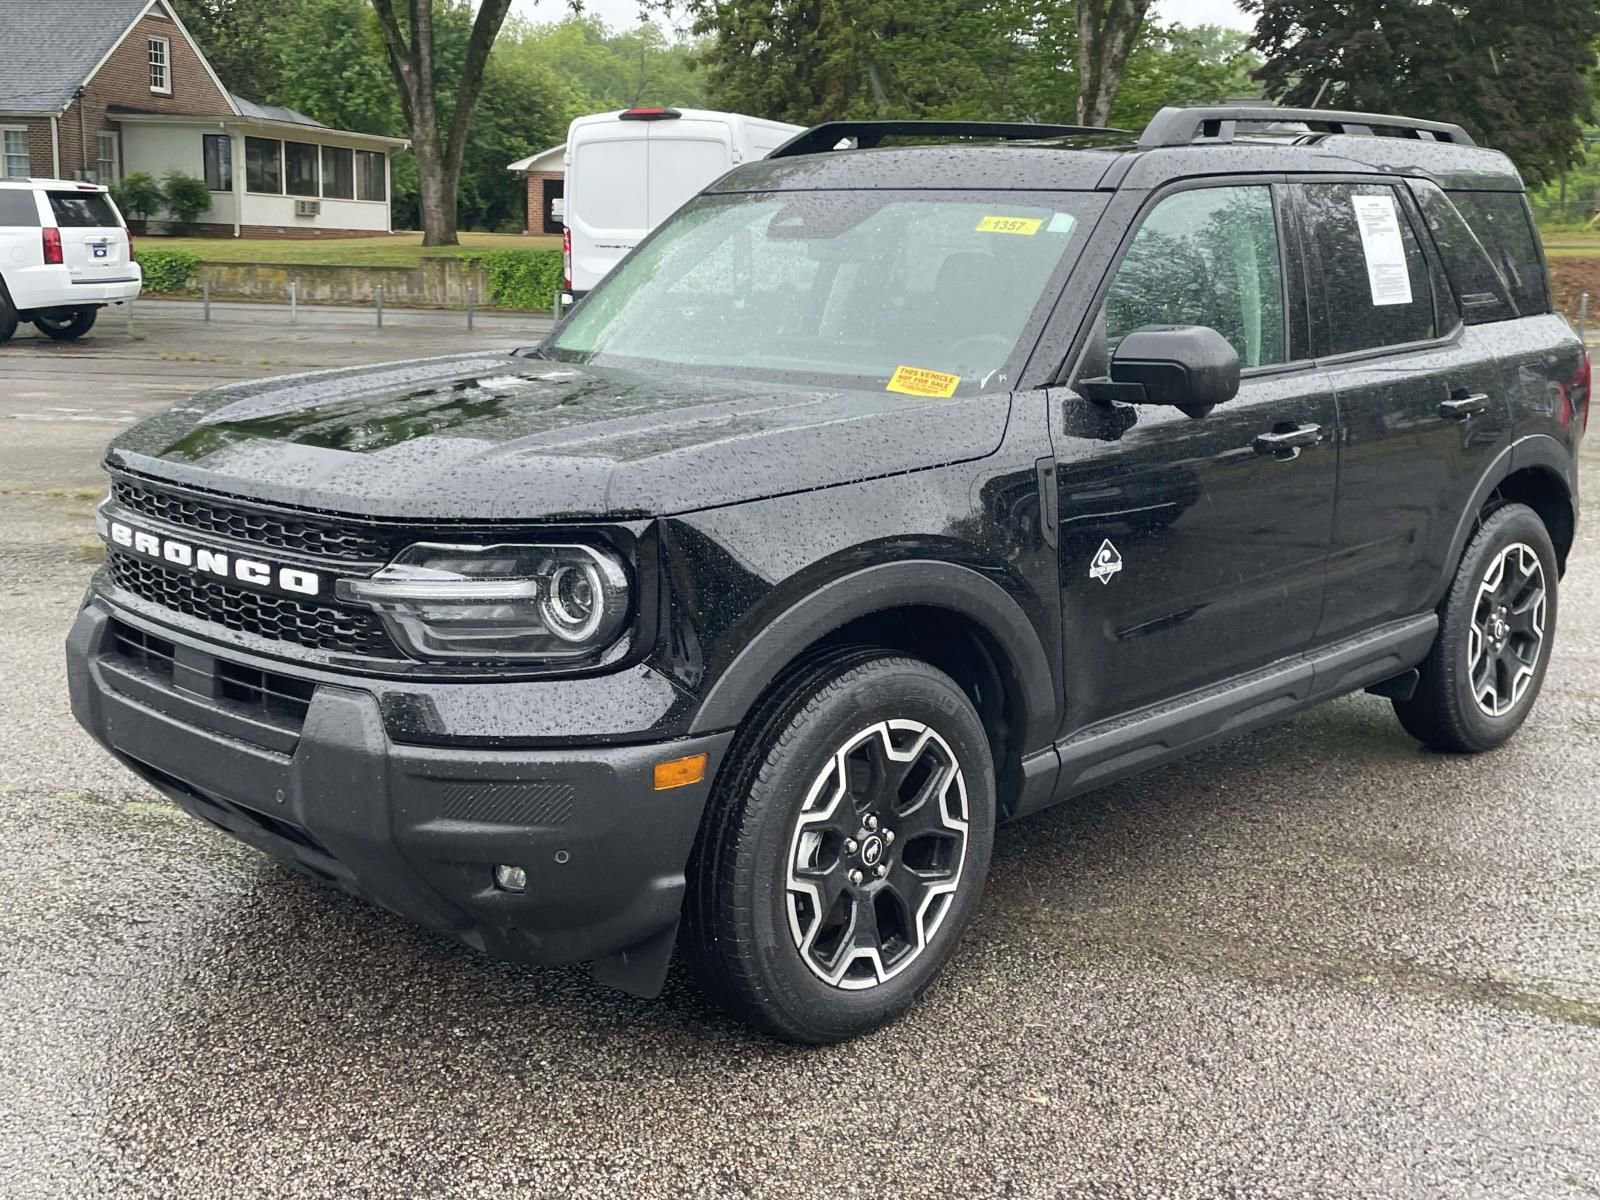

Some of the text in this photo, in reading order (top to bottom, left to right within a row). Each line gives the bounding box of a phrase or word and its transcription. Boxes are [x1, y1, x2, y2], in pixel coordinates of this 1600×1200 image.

[993, 220, 1027, 231] 1357
[898, 374, 913, 382] NOT
[913, 377, 930, 385] FOR
[930, 380, 950, 390] SALE
[900, 367, 955, 384] THIS VEHICLE
[111, 522, 319, 596] BRONCO
